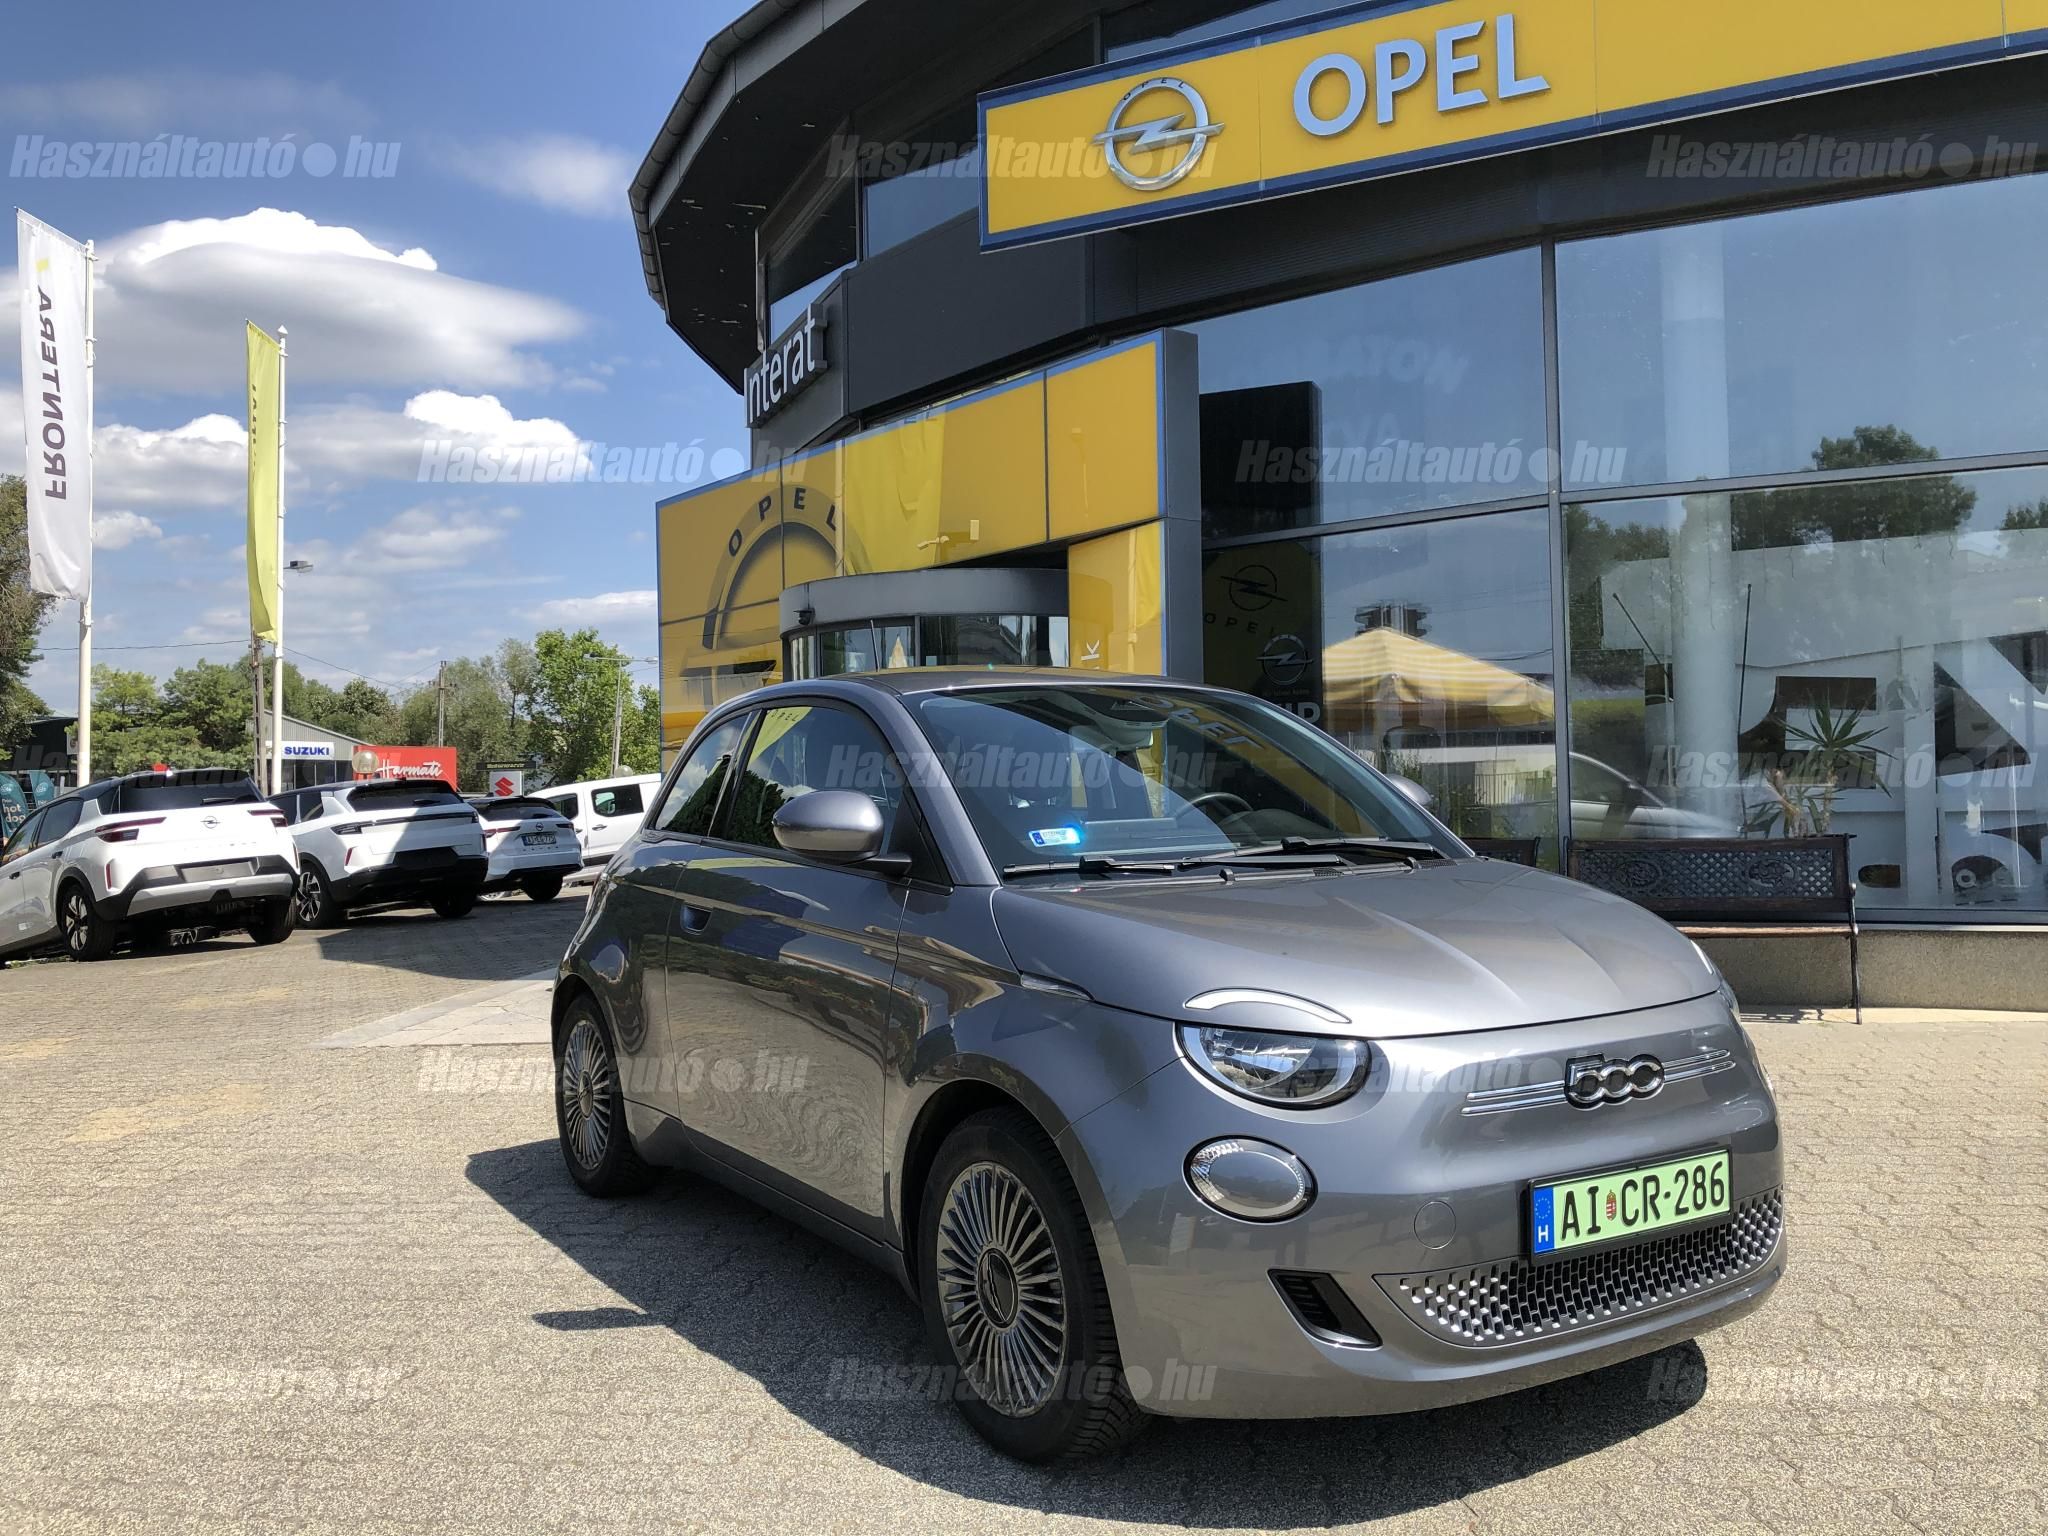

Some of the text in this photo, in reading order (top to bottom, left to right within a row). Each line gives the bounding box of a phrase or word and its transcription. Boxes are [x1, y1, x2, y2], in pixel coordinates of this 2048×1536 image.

[1293, 13, 1550, 137] OPEL
[284, 745, 330, 756] SUZUKI
[376, 759, 443, 780] Harmati
[2, 802, 21, 813] hot
[1566, 1057, 1663, 1105] 500
[1561, 1185, 1601, 1240] AI
[1537, 1224, 1549, 1244] H
